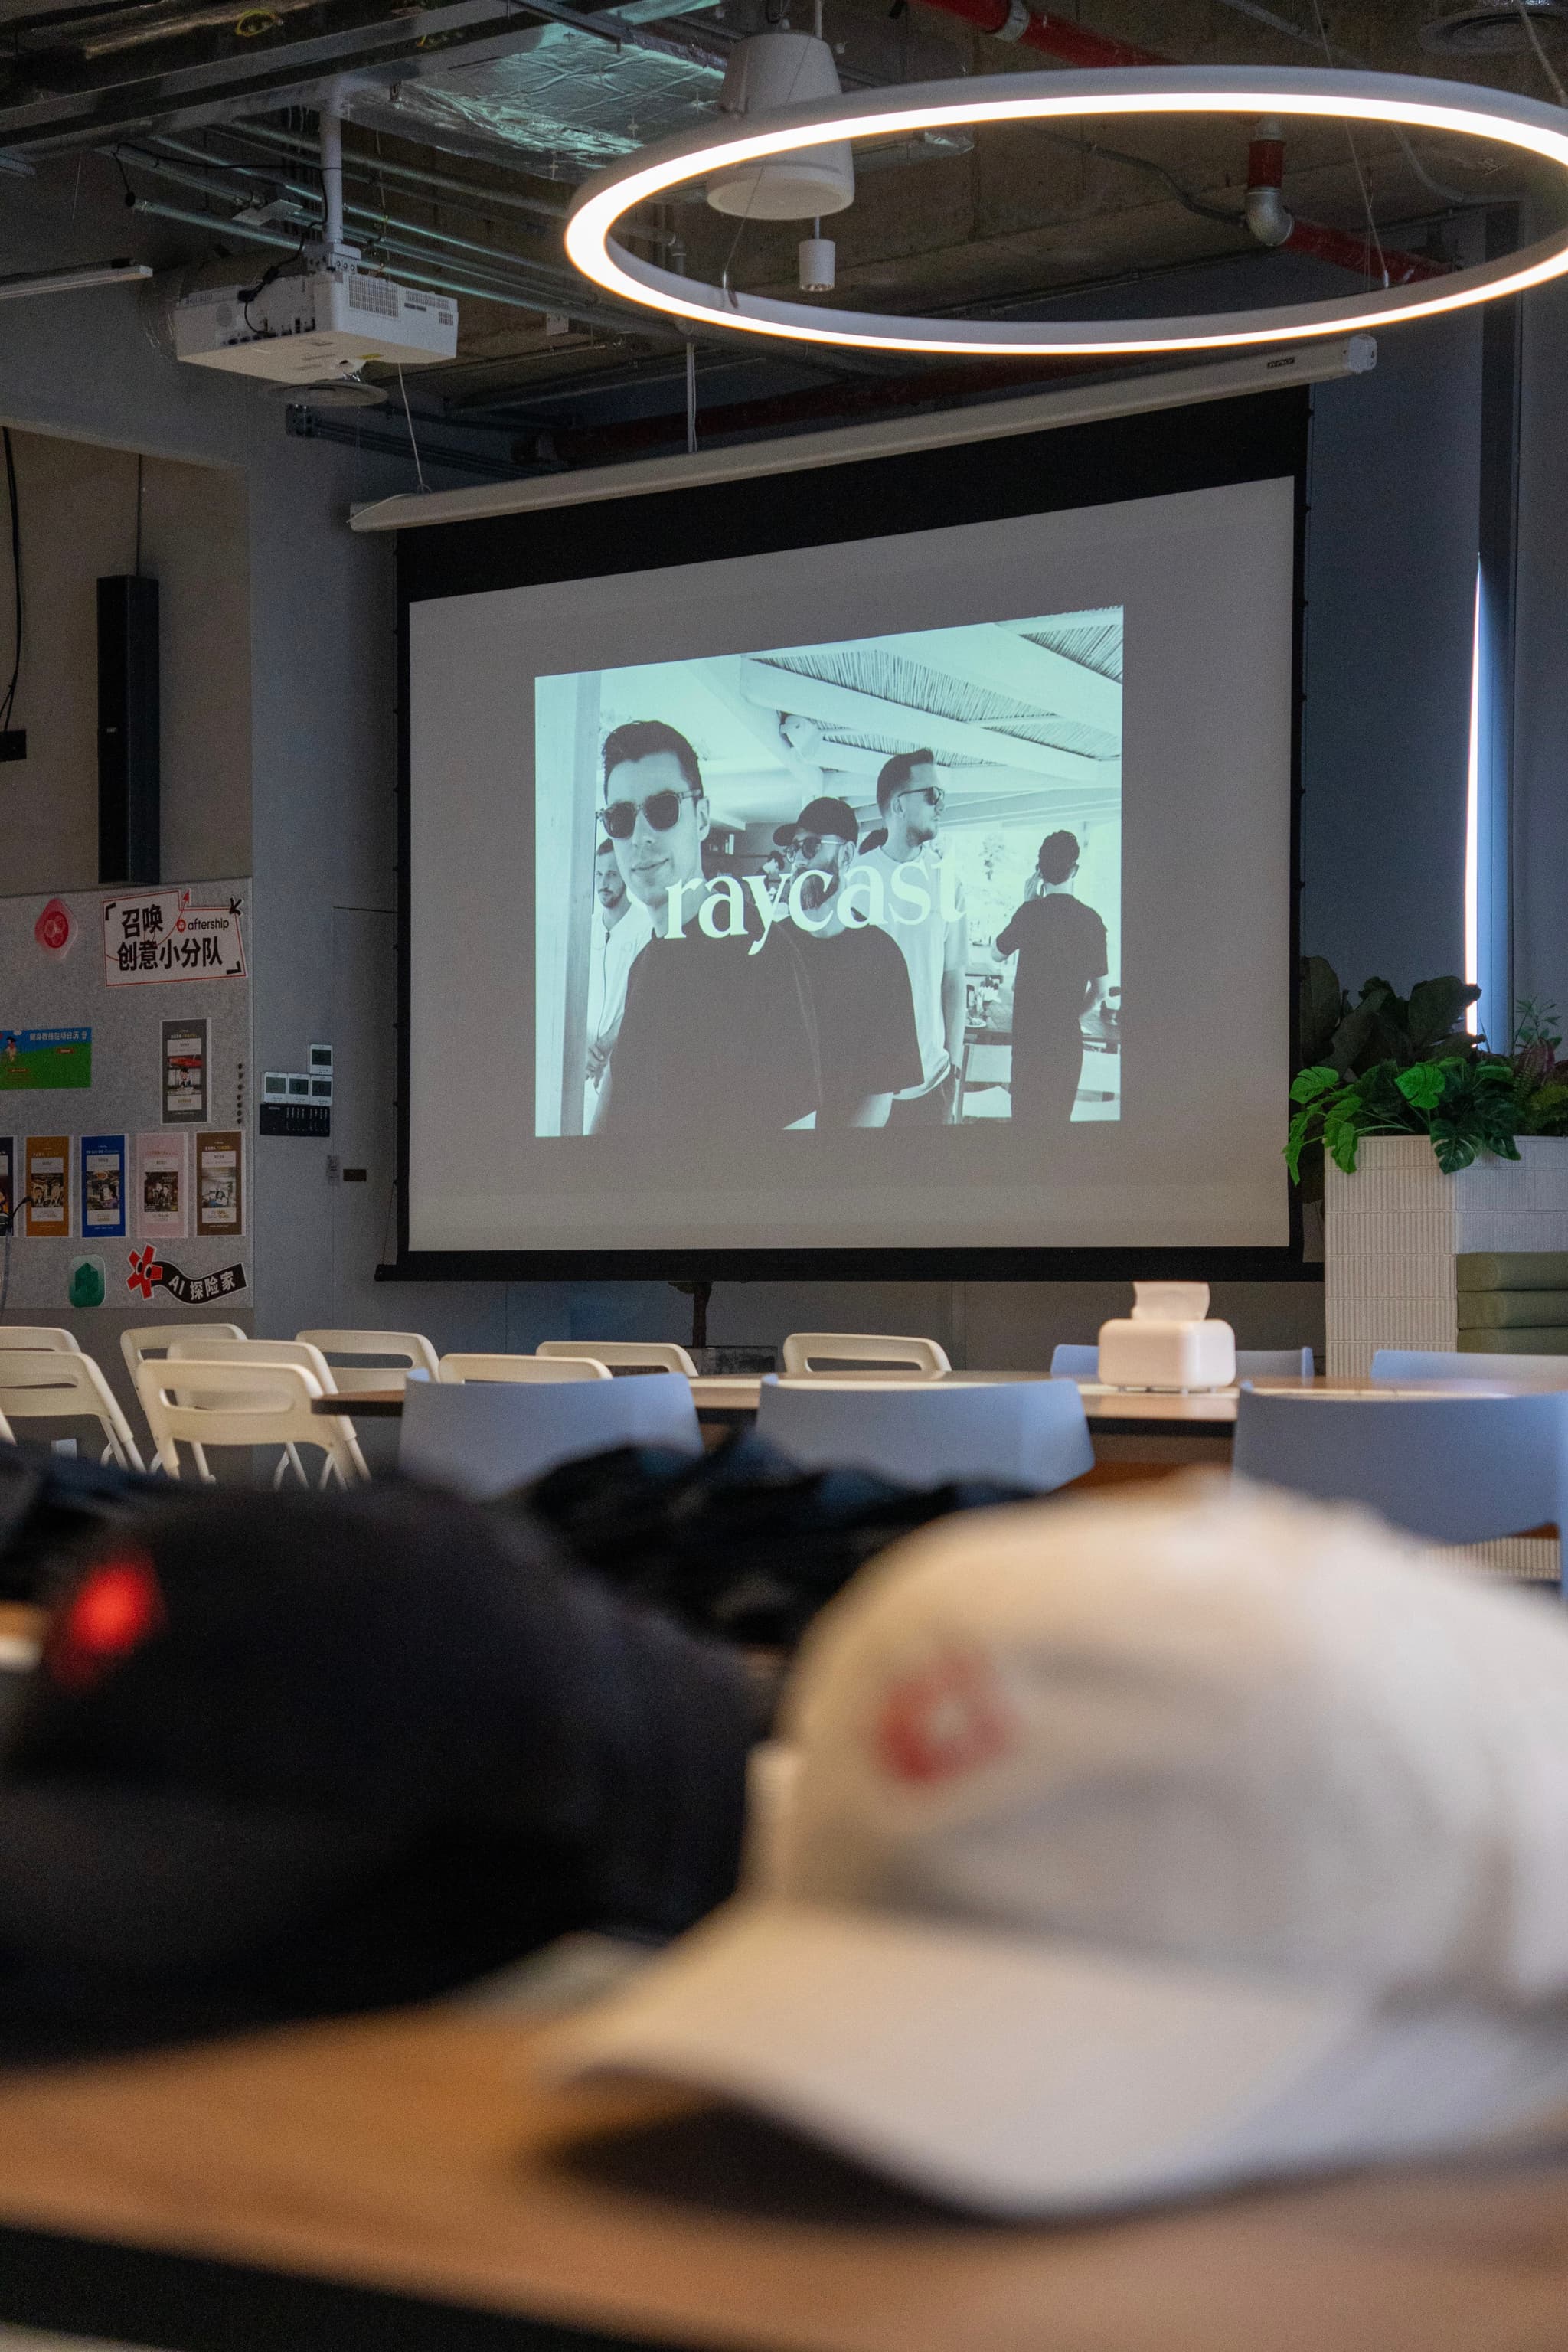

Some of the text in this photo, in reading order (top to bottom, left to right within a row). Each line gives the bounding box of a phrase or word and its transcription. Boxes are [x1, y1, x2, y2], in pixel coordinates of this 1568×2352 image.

[664, 848, 967, 956] raycast
[121, 903, 163, 939] 召唤
[188, 917, 230, 931] aftership
[116, 936, 223, 971] 创意小分队
[168, 1271, 236, 1300] AI 探险家
